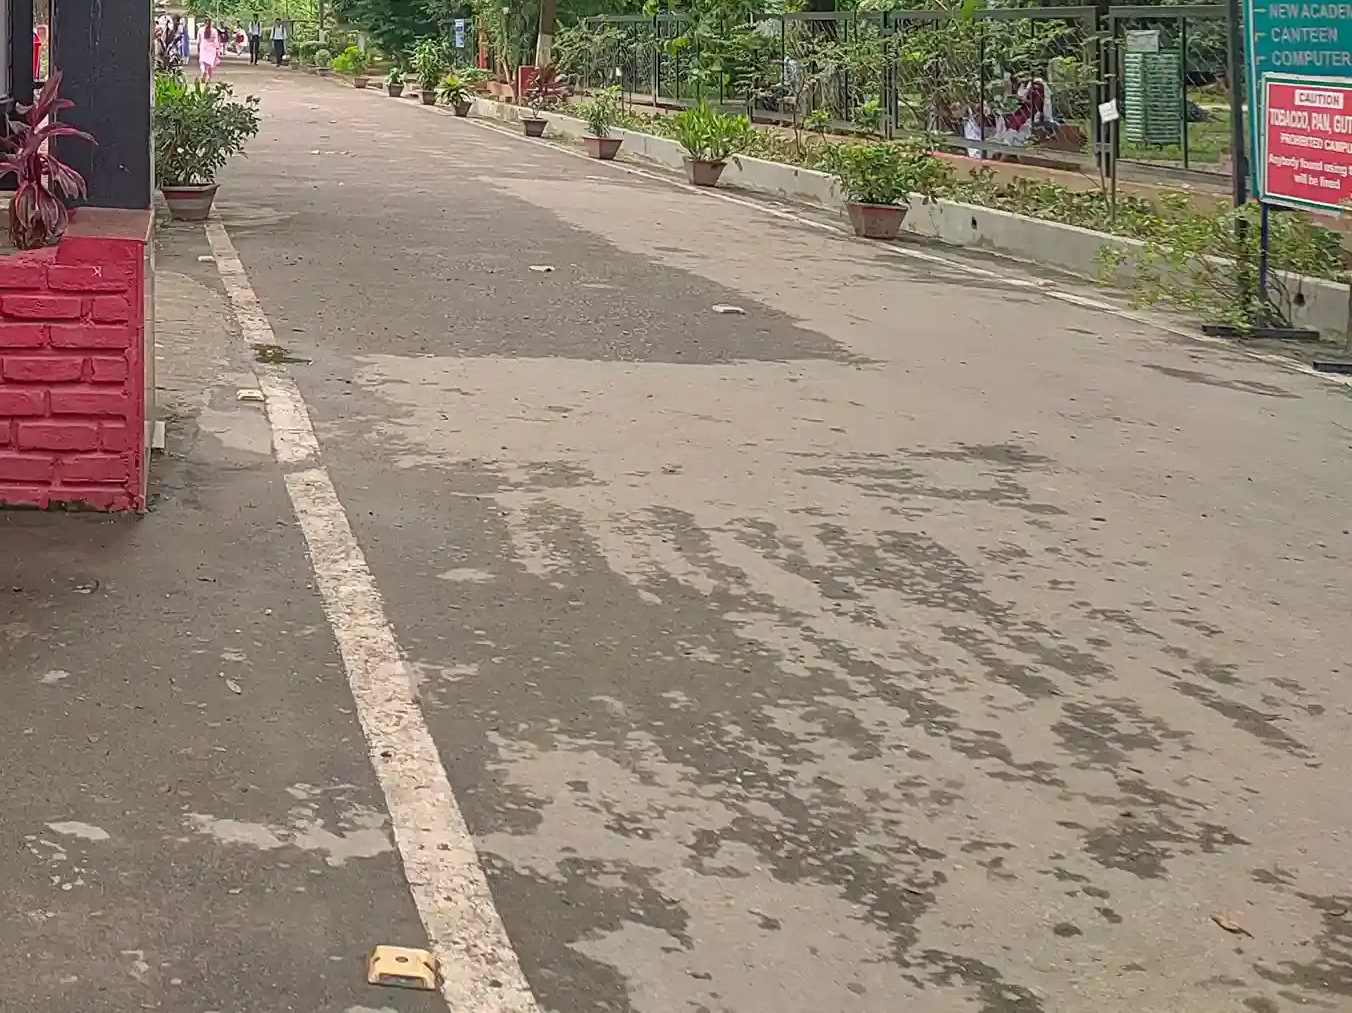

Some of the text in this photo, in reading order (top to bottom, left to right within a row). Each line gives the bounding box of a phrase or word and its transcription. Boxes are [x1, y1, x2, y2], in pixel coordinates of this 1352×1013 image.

[1269, 3, 1299, 19] NEW
[1271, 27, 1338, 43] CANTEEN
[1271, 50, 1352, 67] COMPUTER
[1299, 92, 1340, 106] CAUTION
[1311, 112, 1332, 134] PAN,
[1269, 154, 1299, 170] Anybody
[1309, 175, 1319, 187] be
